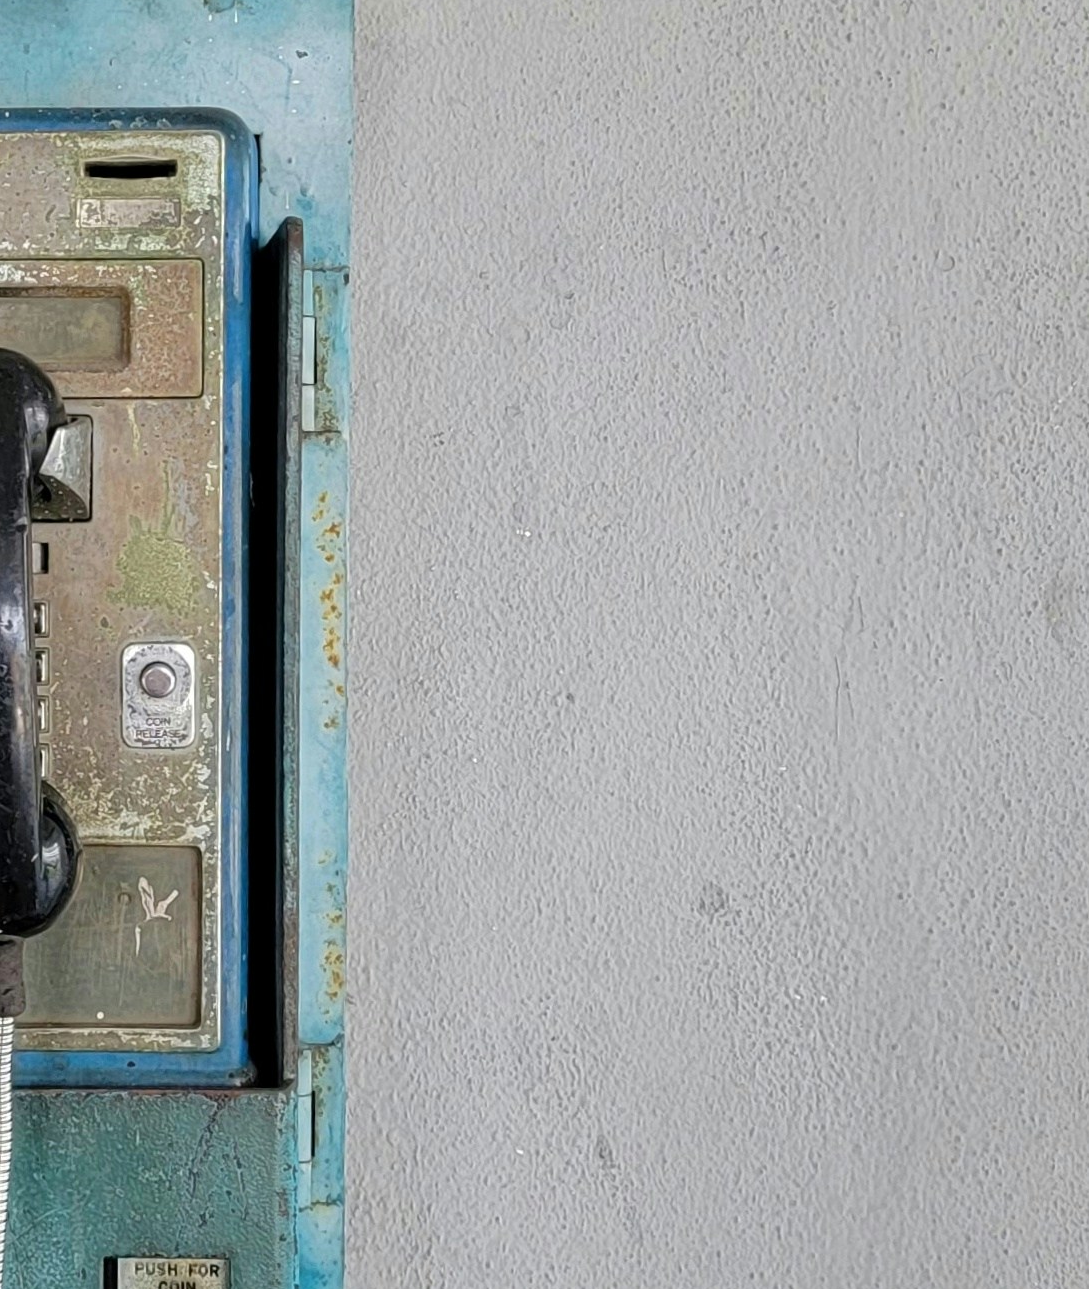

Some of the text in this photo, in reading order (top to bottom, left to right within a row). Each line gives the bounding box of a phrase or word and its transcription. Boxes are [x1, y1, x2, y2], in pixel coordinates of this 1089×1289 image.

[146, 717, 171, 727] COIN
[135, 729, 181, 739] RELEASE
[134, 1262, 220, 1278] PUSH FOR
